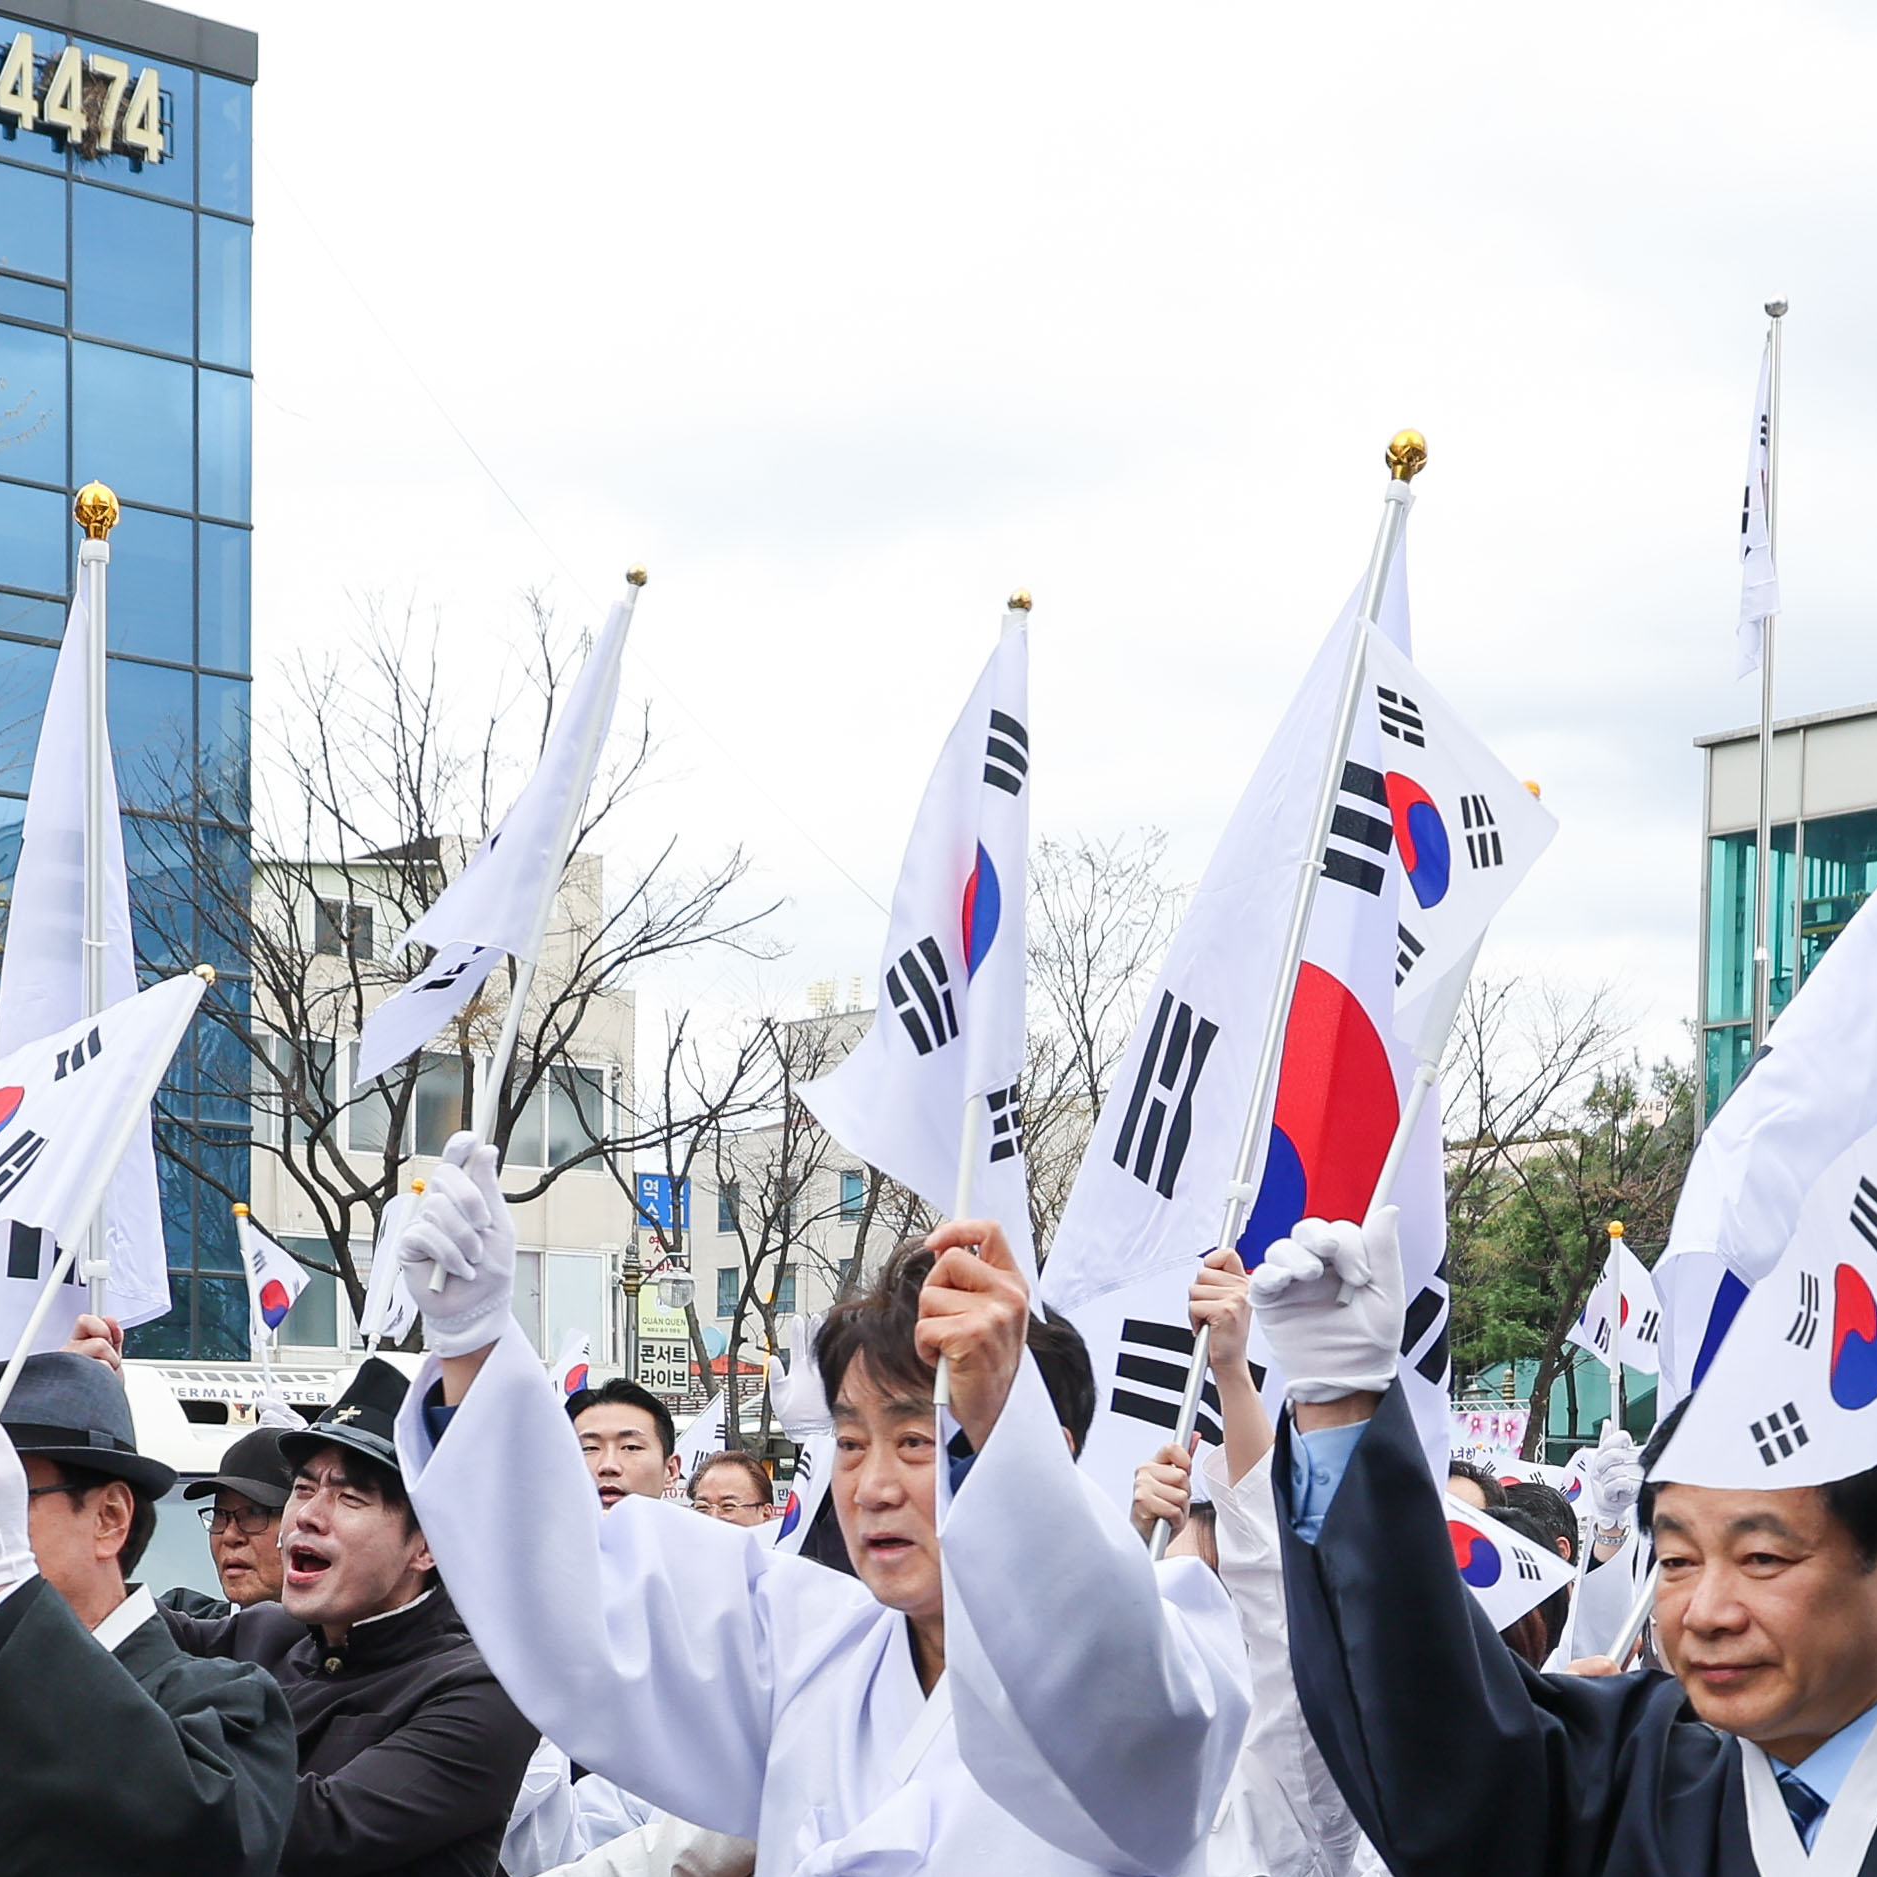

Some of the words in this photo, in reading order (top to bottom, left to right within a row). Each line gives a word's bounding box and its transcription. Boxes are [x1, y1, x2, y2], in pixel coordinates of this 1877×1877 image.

[640, 1344, 687, 1364] 콘서트
[640, 1369, 687, 1388] 라이브
[171, 1386, 243, 1399] ERMAL
[251, 1389, 327, 1402] MSTER
